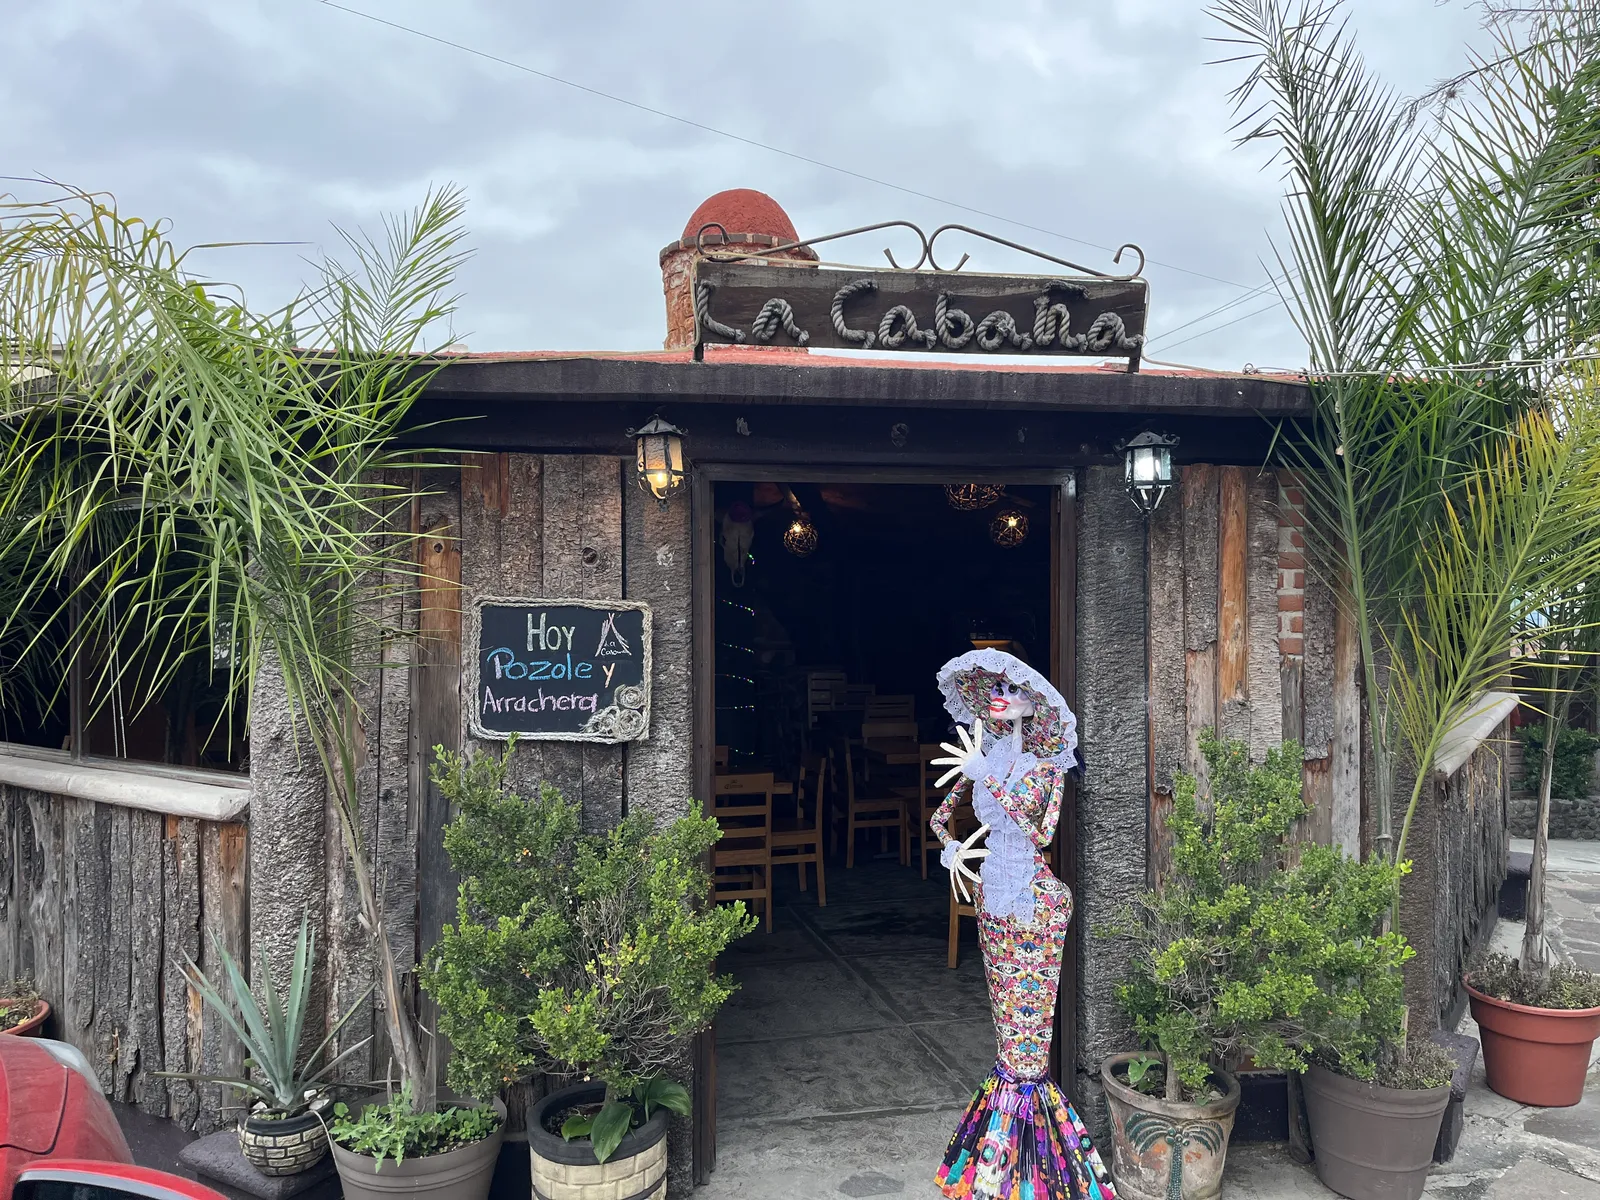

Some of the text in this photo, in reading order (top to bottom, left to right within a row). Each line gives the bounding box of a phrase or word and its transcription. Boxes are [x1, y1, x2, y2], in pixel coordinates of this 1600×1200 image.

[698, 278, 1143, 353] La Cabaña
[486, 647, 593, 681] Pozole
[482, 685, 599, 714] Arrachera
